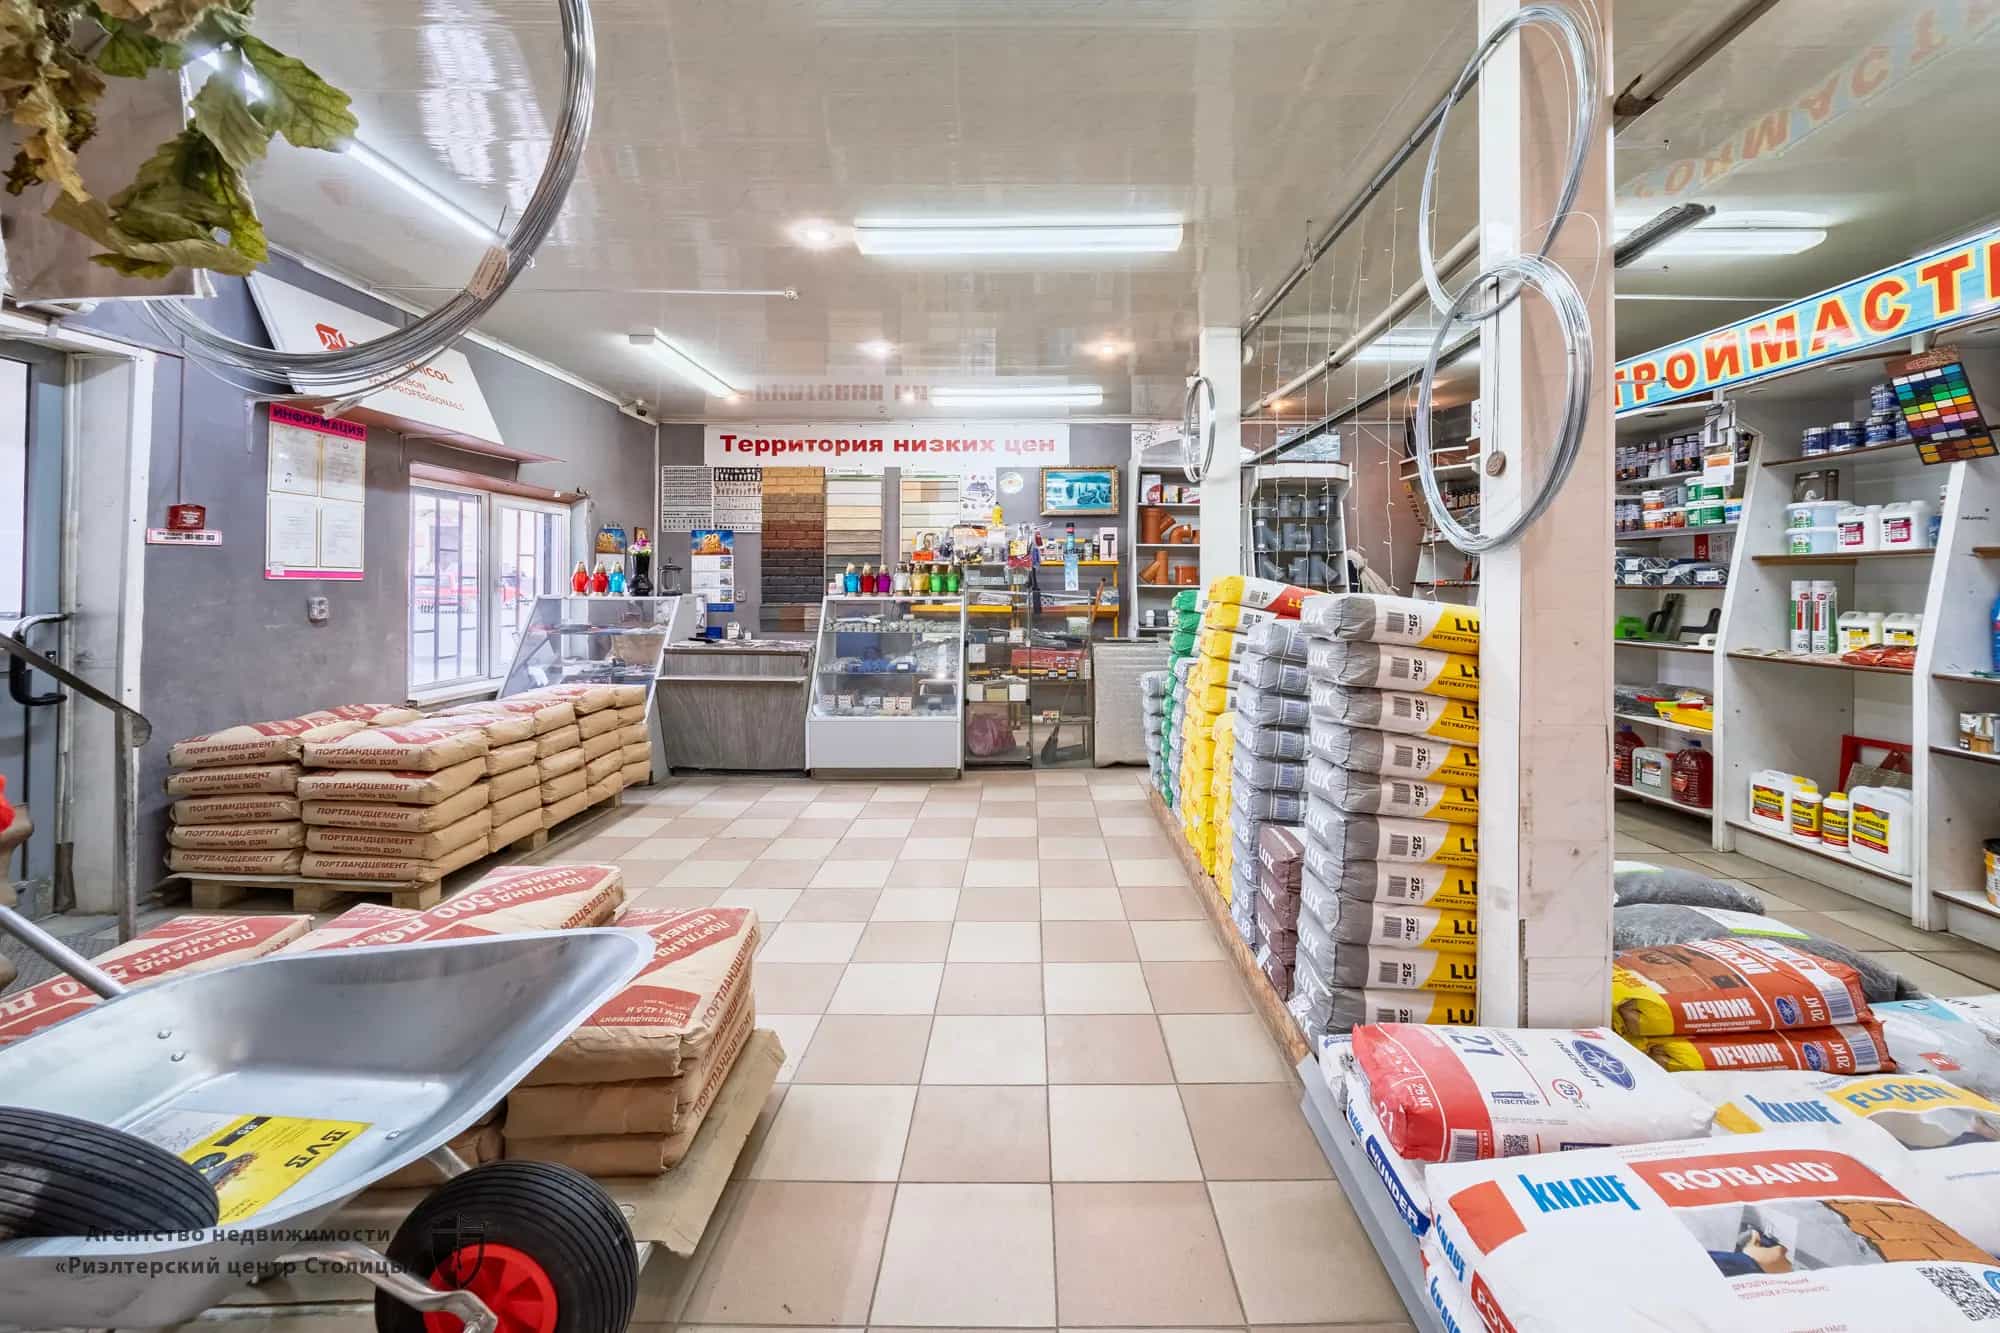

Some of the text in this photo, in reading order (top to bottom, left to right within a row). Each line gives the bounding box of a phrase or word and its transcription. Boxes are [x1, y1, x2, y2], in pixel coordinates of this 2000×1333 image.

[273, 407, 365, 436] ИНФОРМАЦИЯ
[720, 434, 1055, 457] Территория низких цен
[1408, 613, 1418, 627] 25
[1413, 659, 1423, 672] 25
[1415, 699, 1424, 713] 25
[185, 741, 276, 755] ПОРТЛАНДЦЕМЕНТ
[315, 748, 409, 756] ПОРТЛАНДЦЕМЕНТ
[1417, 747, 1426, 762] 25
[178, 771, 271, 783] ПОРТЛАНДЦЕМЕНТ
[311, 782, 410, 791] ПОРТЛАНДЦЕМЕНТ
[1414, 784, 1424, 798] 25
[190, 801, 281, 812] ПОРТЛАНДЦЕМЕНТ
[316, 807, 410, 820] ПОРТЛАНДЦЕМЕНТ
[184, 828, 280, 838] ПОРТЛАНДЦЕМЕНТ
[320, 833, 416, 845] ПОРТЛАНДЦЕМЕНТ
[1412, 835, 1422, 850] 25
[183, 853, 276, 863] ПОРТЛАНДЦЕМЕНТ
[315, 860, 409, 869] ПОРТЛАНДЦЕМЕНТ
[1258, 843, 1274, 873] LUX
[496, 875, 587, 902] ПОРТЛАНД
[1260, 878, 1277, 910] LUX
[1411, 877, 1420, 892] 25
[434, 891, 496, 920] 500
[656, 912, 718, 947] ЦЕМЕН
[1257, 911, 1272, 944] LUX
[1406, 917, 1415, 932] 25
[131, 924, 250, 967] ЦЕМЕНТ
[655, 920, 731, 957] ПОРТЛАНД
[134, 931, 257, 973] ПОРТЛАНД
[702, 925, 757, 1030] ПОРТЛАНДЦЕМЕНТ
[1402, 963, 1412, 977] 25
[1447, 1008, 1474, 1024] LU
[1682, 998, 1756, 1020] ПЕЧНИК
[1811, 1008, 1825, 1022] 20
[1450, 1034, 1505, 1057] 21
[1710, 1043, 1784, 1066] ПЕЧНИК
[693, 1012, 753, 1117] ПОРТЛАНДЦЕМЕНТ
[1836, 1055, 1850, 1069] 20
[1845, 1083, 1956, 1109] FUGEN
[1744, 1094, 1842, 1125] KNAUF
[1658, 1160, 1839, 1191] ROTBAND
[1517, 1173, 1641, 1214] KNAUF
[1436, 1213, 1467, 1283] KNAUF
[1430, 1275, 1462, 1333] KNAU
